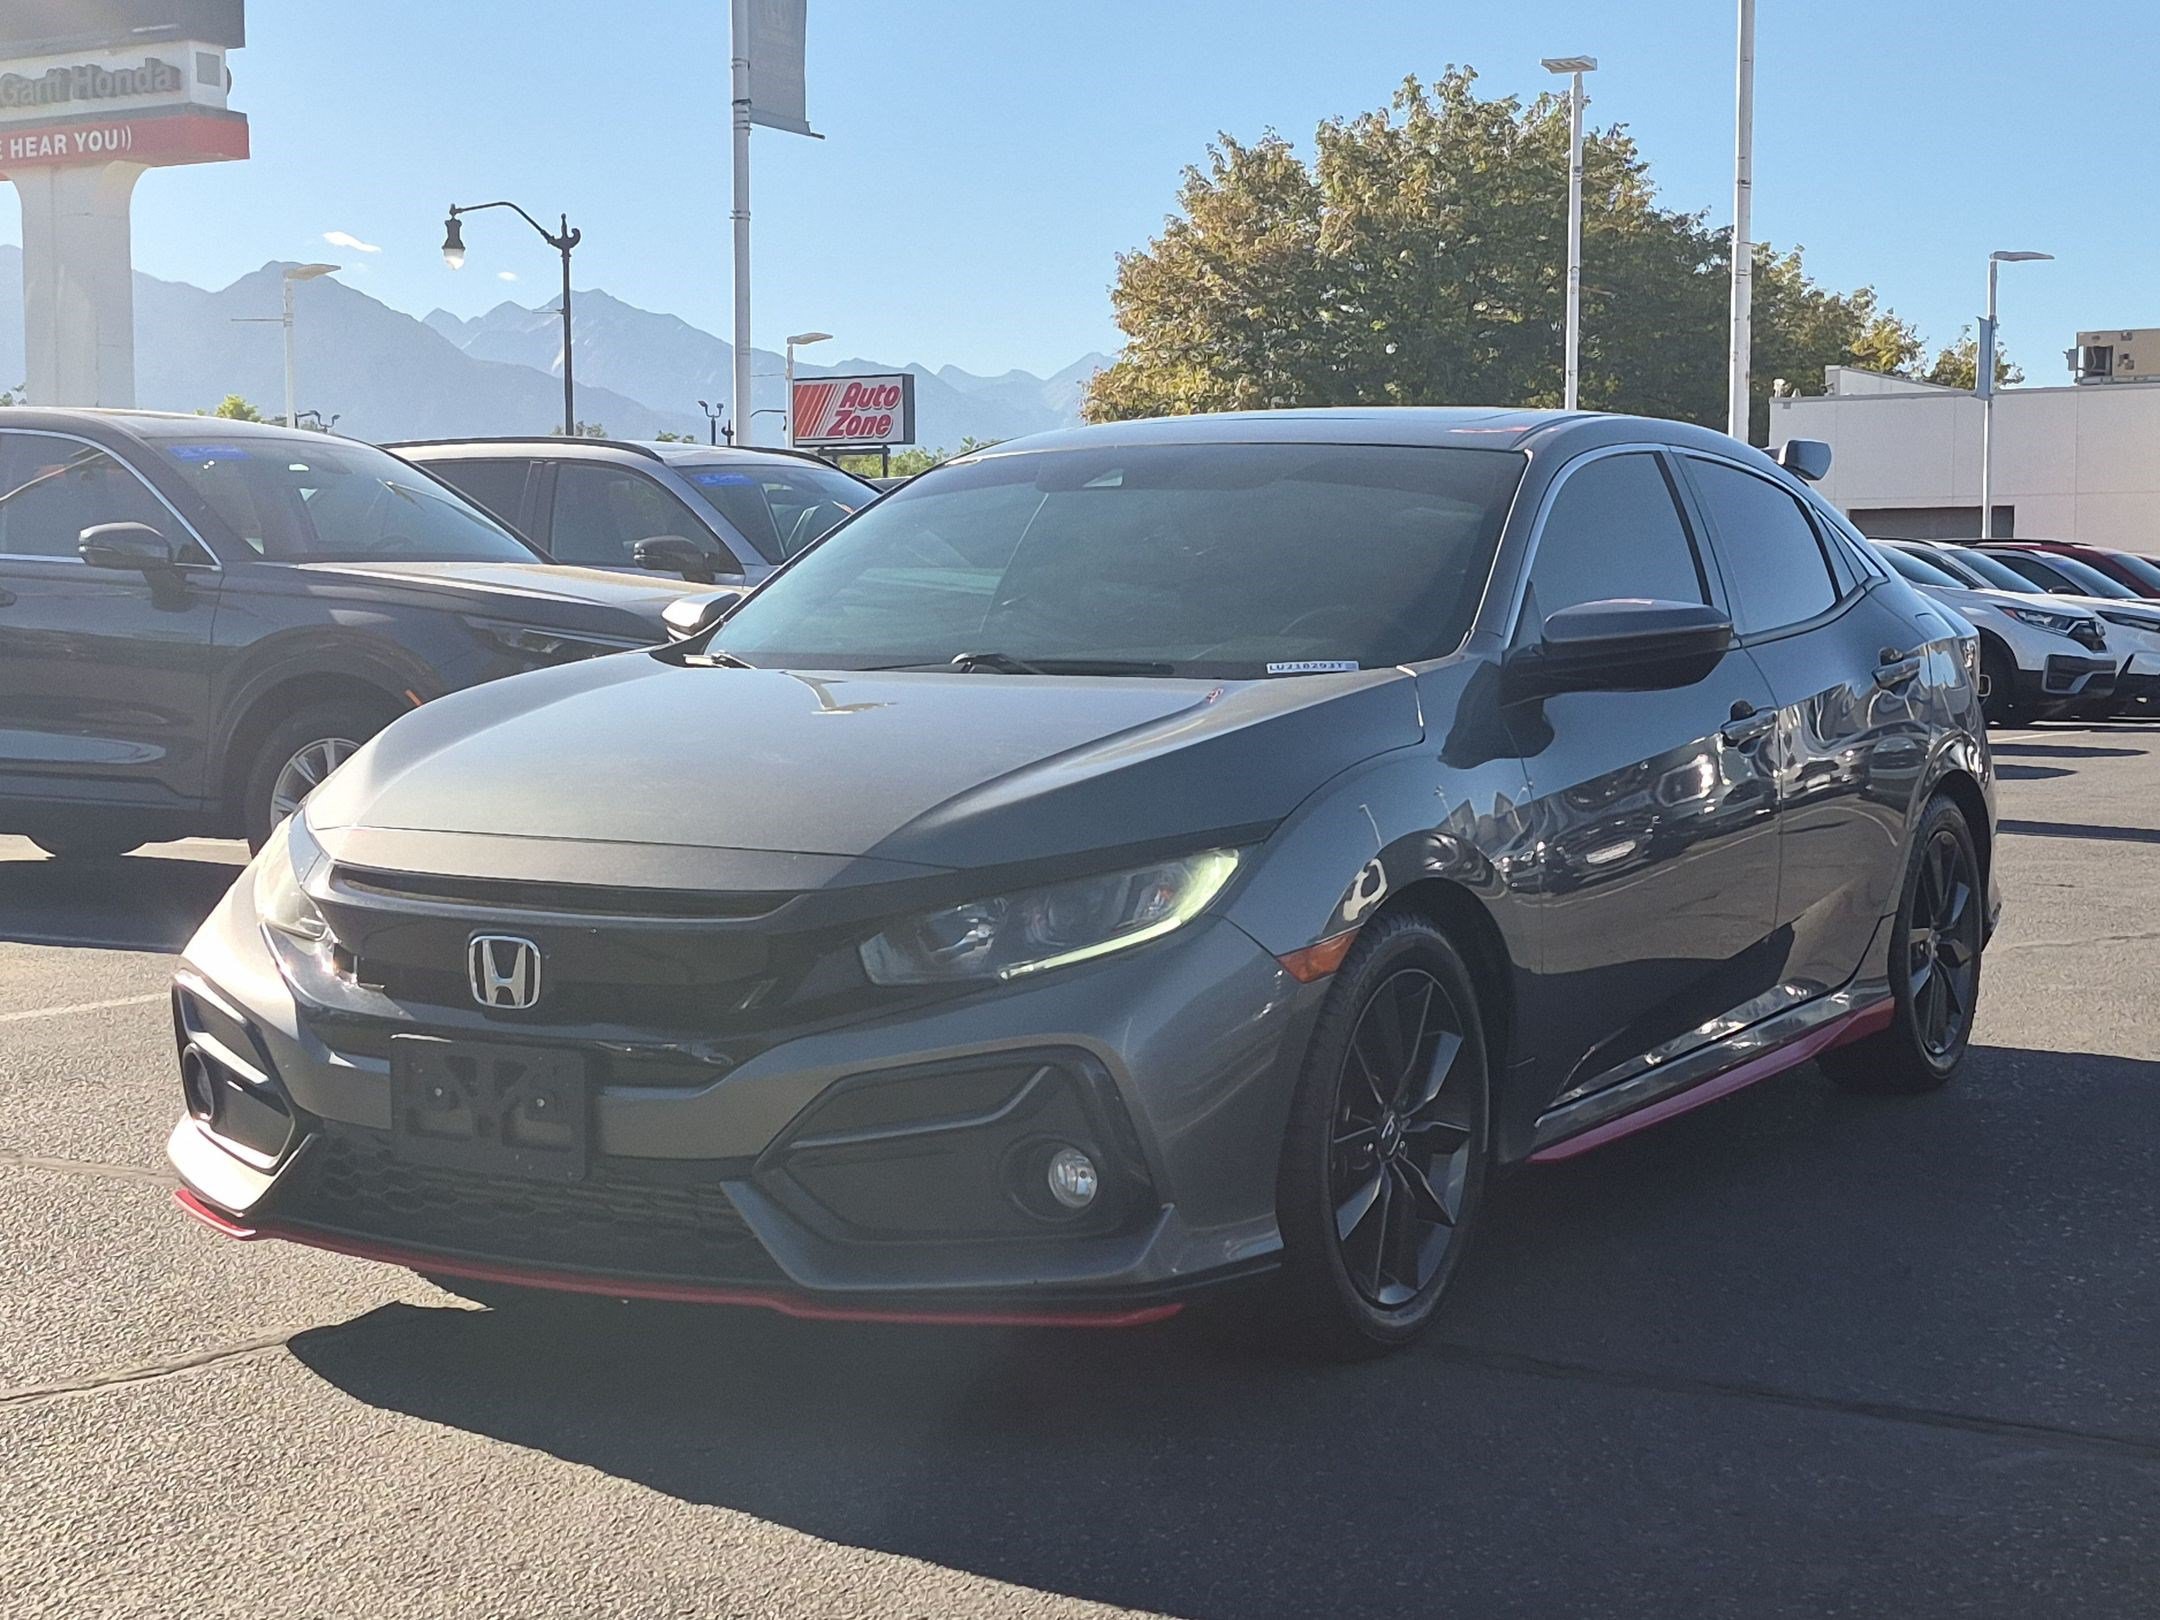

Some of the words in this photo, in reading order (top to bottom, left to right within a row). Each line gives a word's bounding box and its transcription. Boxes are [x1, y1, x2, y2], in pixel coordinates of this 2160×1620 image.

[71, 57, 182, 99] Honda
[10, 134, 67, 159] HEAR
[839, 382, 901, 409] Auto
[826, 409, 892, 438] Zone
